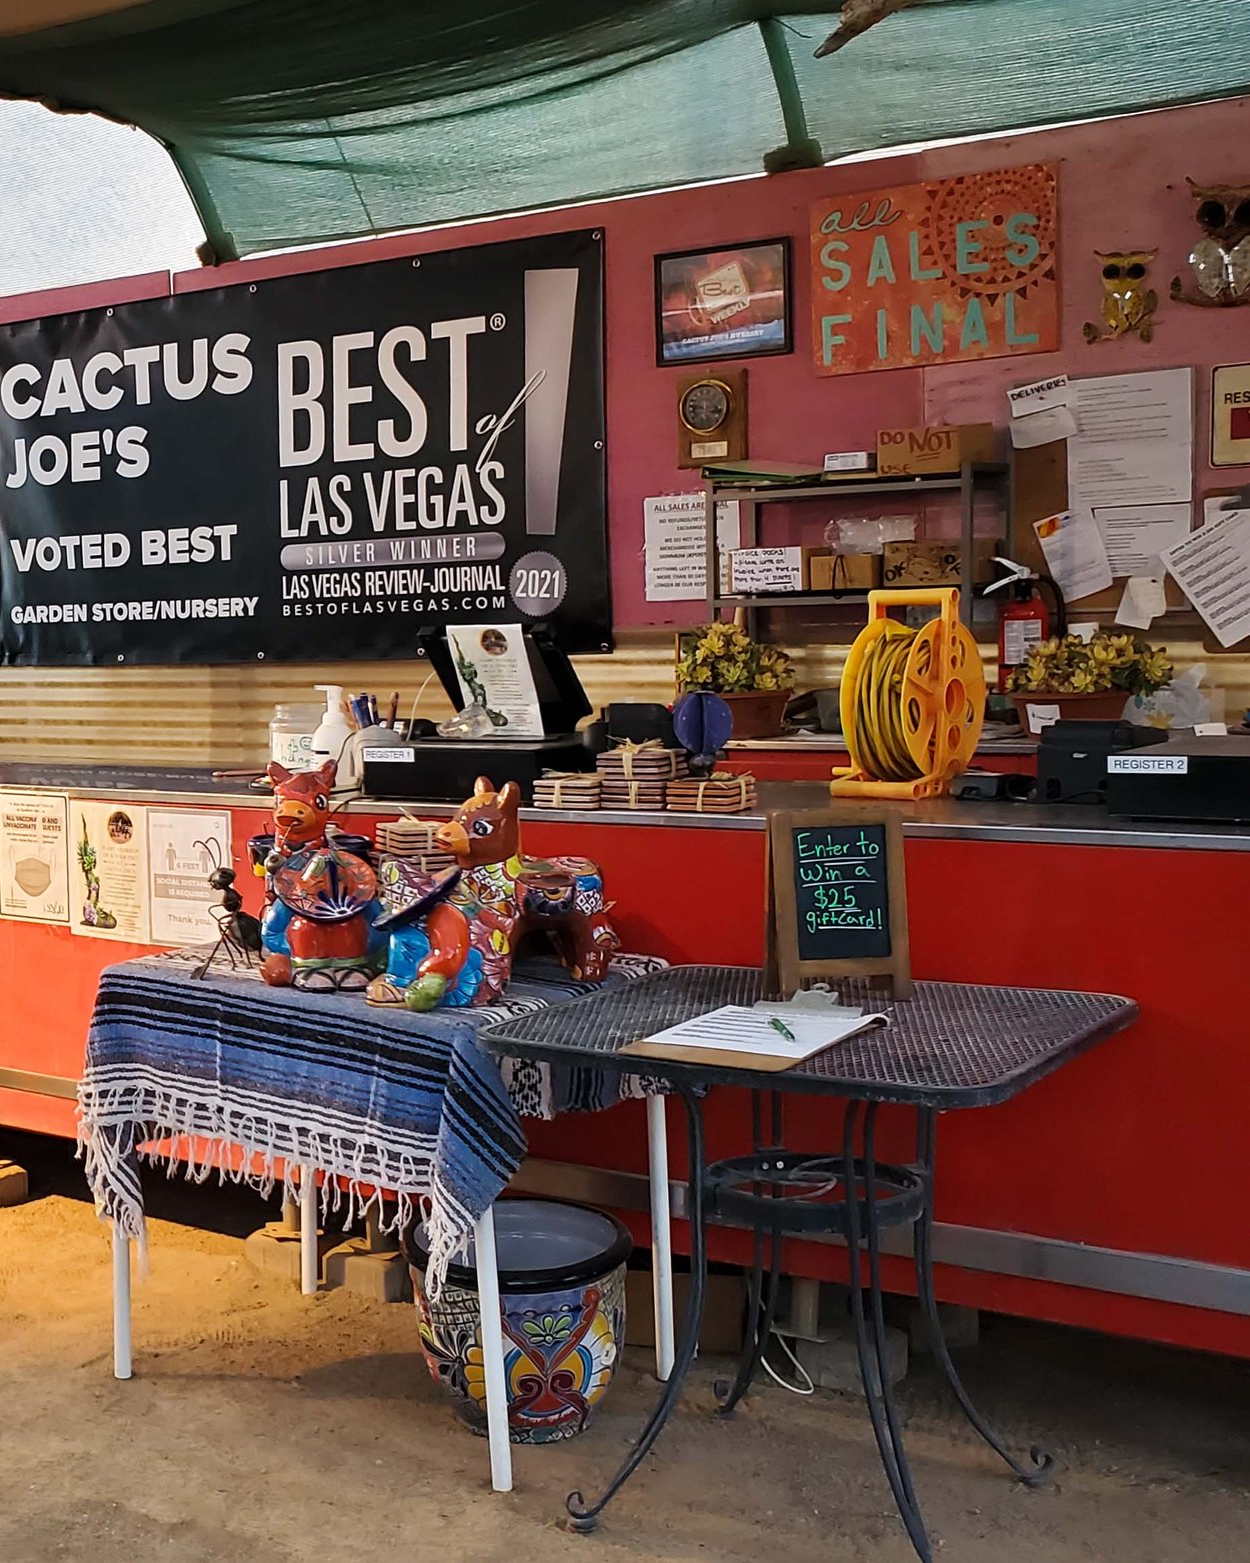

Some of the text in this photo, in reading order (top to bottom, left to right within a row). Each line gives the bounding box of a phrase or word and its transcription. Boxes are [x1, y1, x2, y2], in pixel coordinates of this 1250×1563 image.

[820, 198, 903, 235] all
[819, 212, 1040, 292] SALES
[821, 292, 1039, 366] FINAL
[0, 332, 254, 420] CACTUS
[277, 315, 487, 469] BEST
[1011, 378, 1067, 402] DELIVERIES
[474, 368, 548, 474] of
[879, 427, 957, 453] DO NOT
[5, 425, 151, 489] JOE'S
[880, 464, 912, 475] USE
[279, 460, 507, 539] LAS VEGAS
[654, 504, 666, 512] ALL
[668, 502, 691, 511] SALES
[10, 524, 238, 573] VOTED BEST
[305, 536, 477, 567] SILVER WINNER
[282, 565, 506, 600] LAS VEGAS REVIEW-JOURNAL
[515, 569, 561, 600] 2021
[10, 596, 260, 625] GARDEN STORE/NURSERY
[282, 595, 506, 617] BESTOFLASVEGAS.COM
[365, 750, 405, 759] REGISTER
[1113, 760, 1185, 770] REGISTER 2
[3, 822, 37, 831] UNVACCINATE
[797, 831, 879, 857] Enter to
[182, 862, 200, 871] FEET
[800, 863, 871, 882] Win a
[156, 876, 181, 886] SOCIAL
[176, 889, 210, 898] REQUIRED
[814, 886, 856, 909] $25
[168, 914, 193, 925] Thank
